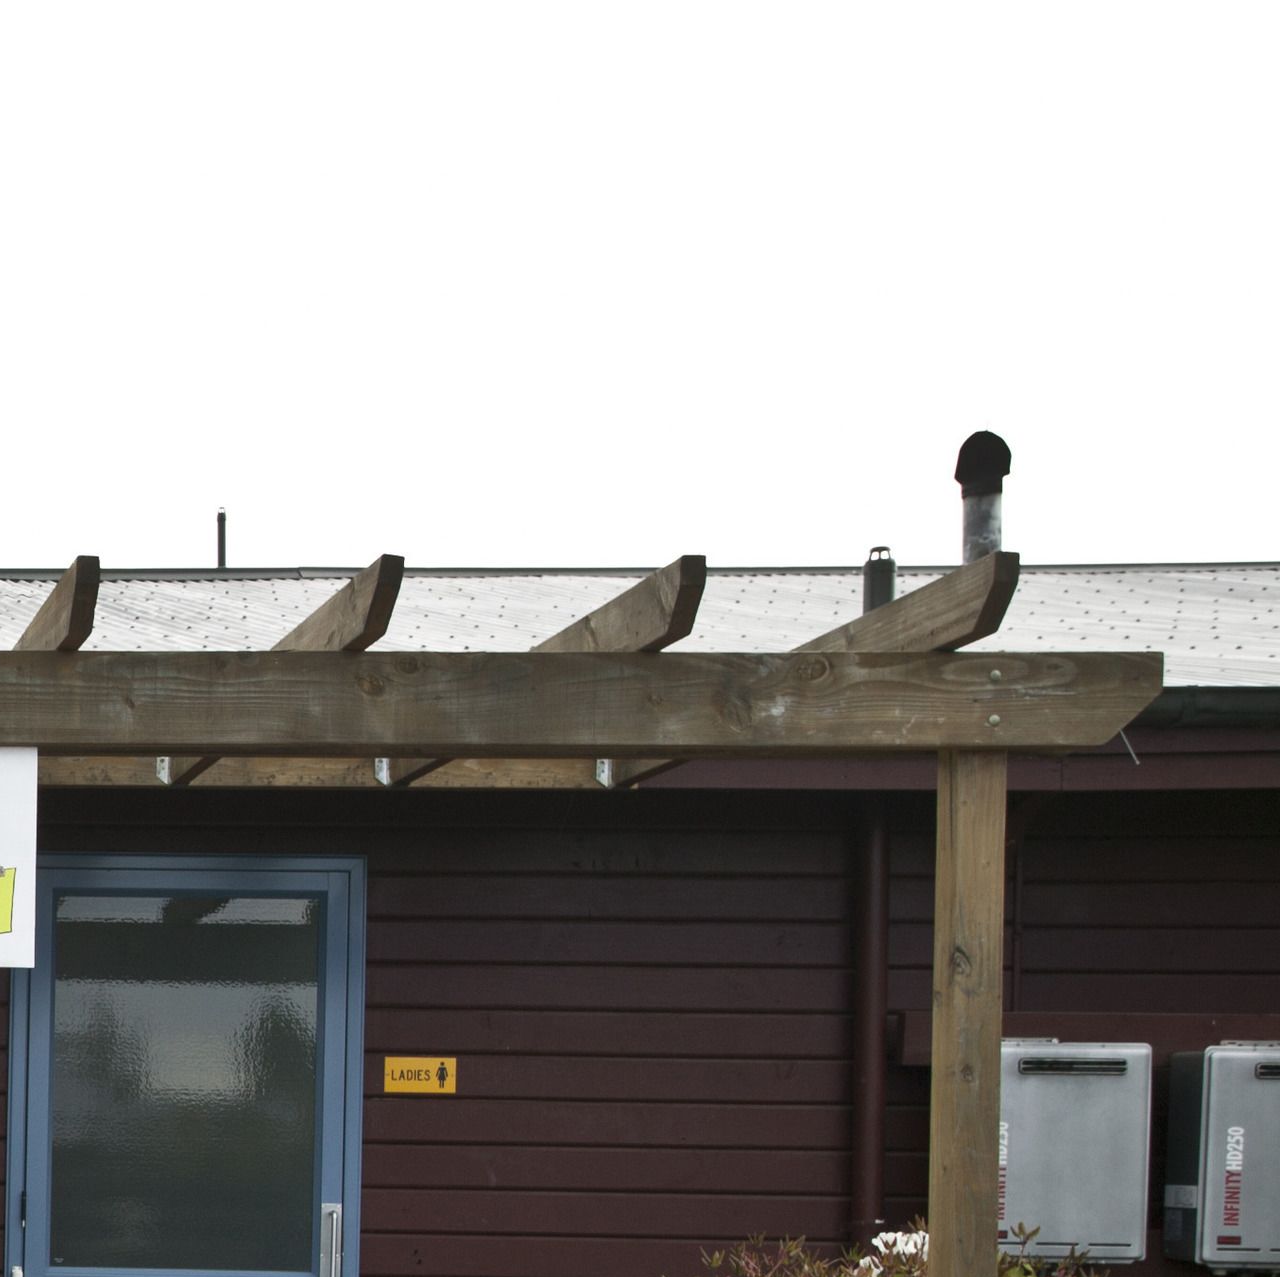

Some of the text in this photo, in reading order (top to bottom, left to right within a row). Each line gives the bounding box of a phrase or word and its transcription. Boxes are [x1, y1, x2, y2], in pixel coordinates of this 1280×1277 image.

[391, 1069, 431, 1081] LADIES
[1223, 1126, 1245, 1226] INFINITY HD250
